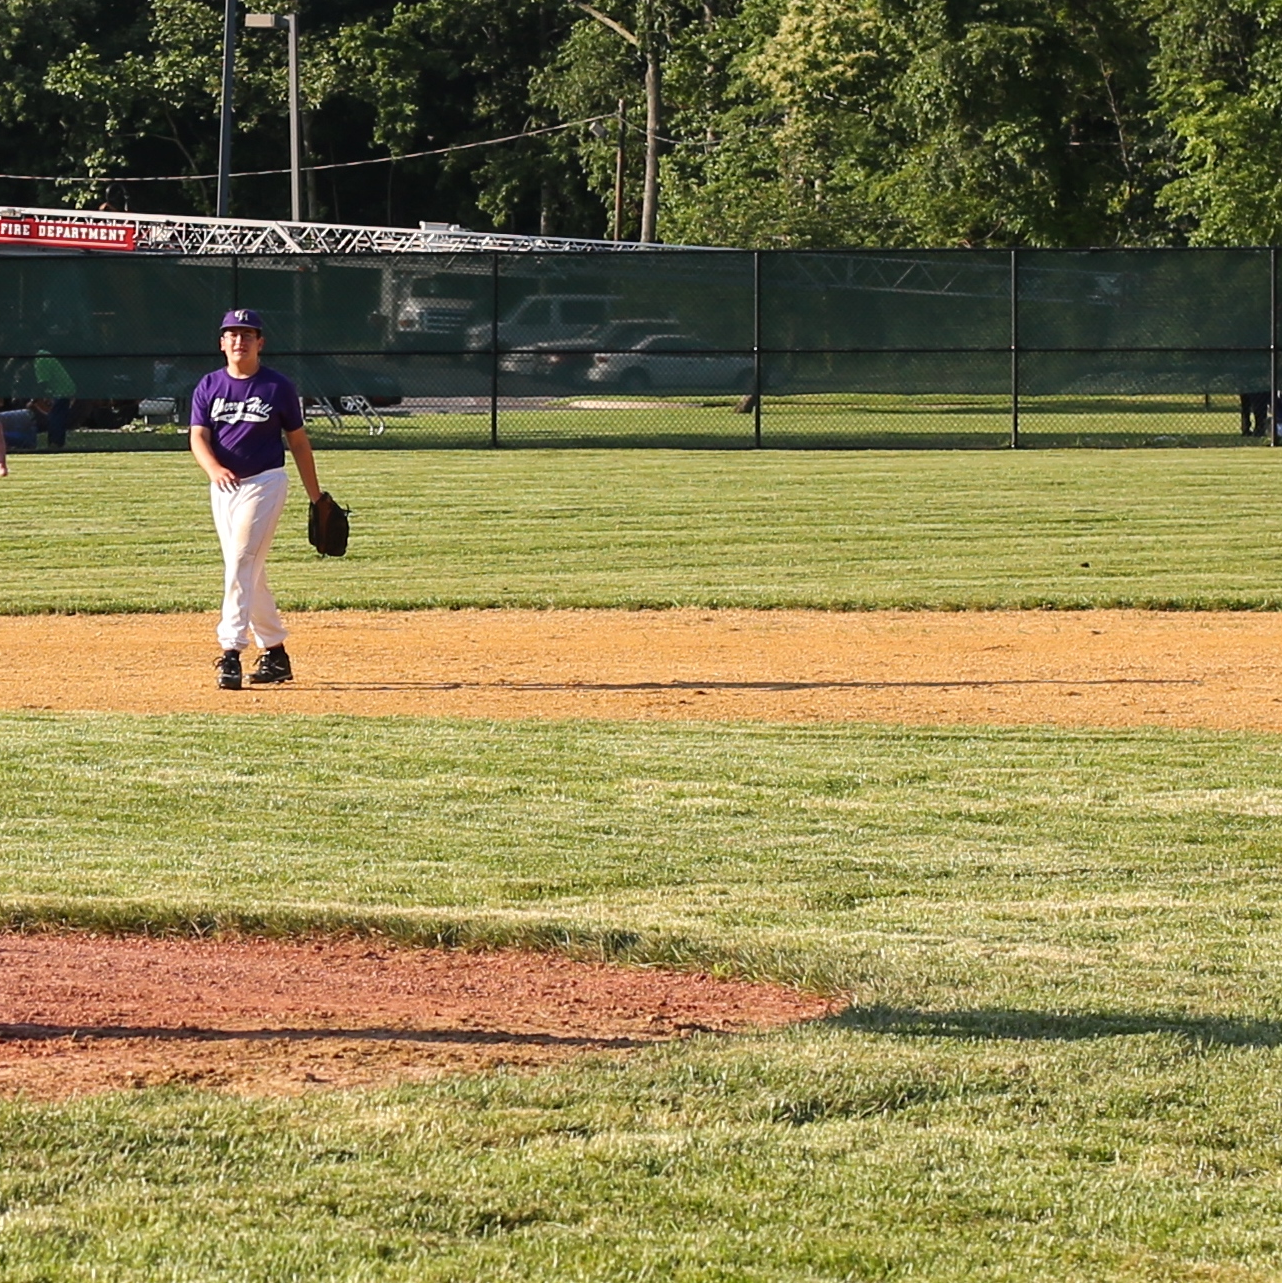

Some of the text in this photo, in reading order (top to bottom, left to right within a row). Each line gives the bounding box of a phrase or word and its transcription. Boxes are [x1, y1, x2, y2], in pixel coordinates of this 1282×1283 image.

[0, 224, 30, 237] FIRE
[38, 226, 126, 242] DEPARTMENT
[245, 396, 273, 416] Hill
